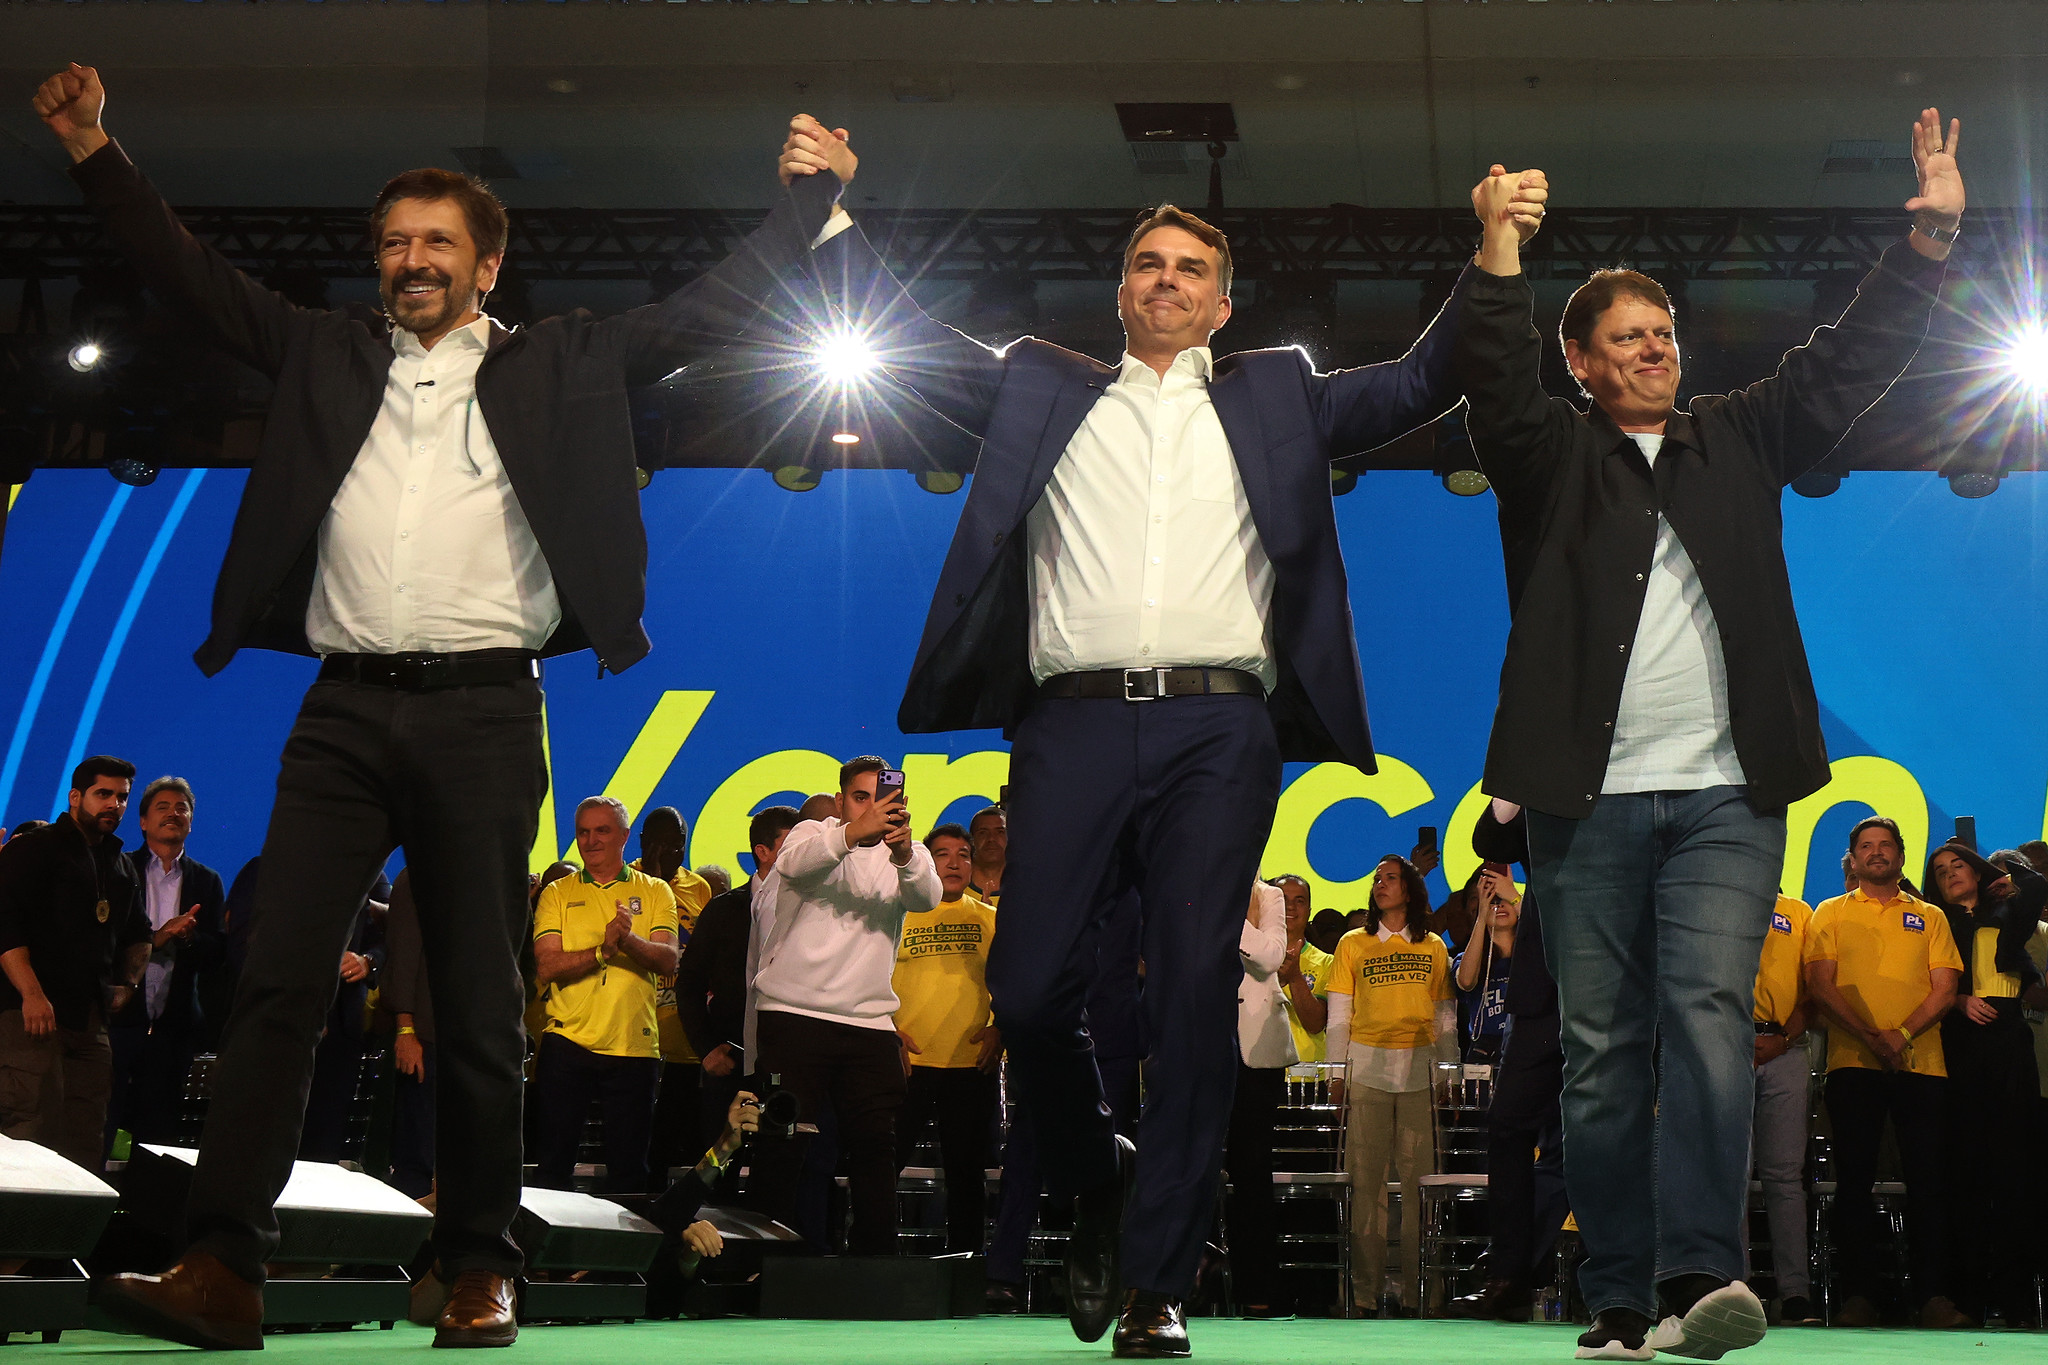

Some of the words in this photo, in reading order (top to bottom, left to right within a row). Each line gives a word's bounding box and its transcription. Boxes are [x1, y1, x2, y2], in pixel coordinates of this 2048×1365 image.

[1774, 915, 1790, 927] PL
[1906, 915, 1922, 925] PL
[906, 926, 933, 935] 2026
[946, 924, 980, 932] MALTA
[915, 933, 980, 944] BOLSONARO
[910, 943, 952, 955] OUTRA
[955, 943, 977, 951] VEZ
[1364, 955, 1389, 966] 2026
[1400, 954, 1431, 962] MALTA
[1373, 962, 1431, 973] BOLSONARO
[1369, 973, 1405, 985] OUTRA
[1408, 972, 1427, 981] VEZ
[1488, 1004, 1504, 1017] BO
